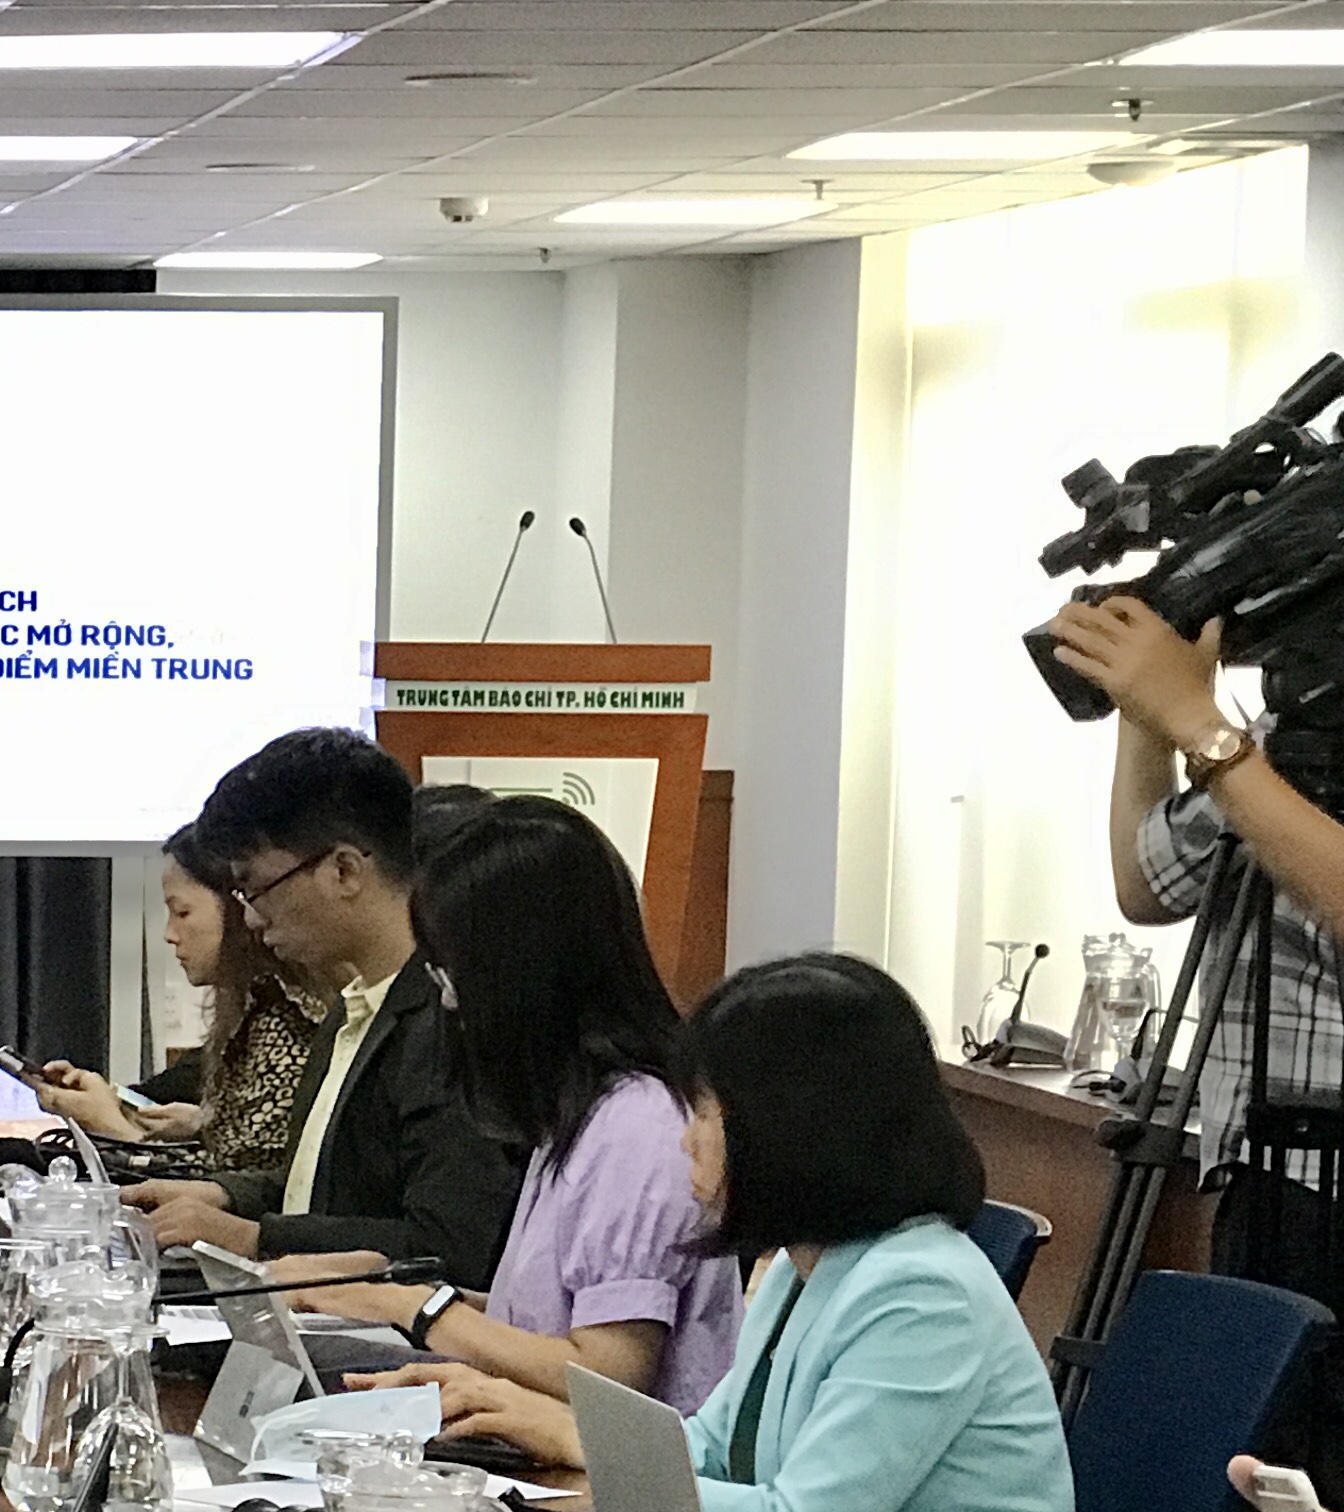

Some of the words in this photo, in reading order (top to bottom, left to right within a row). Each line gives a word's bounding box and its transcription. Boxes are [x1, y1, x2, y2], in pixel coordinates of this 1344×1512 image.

[27, 618, 72, 647] MỞ
[81, 620, 175, 650] RỘNG,
[66, 650, 142, 680] MIỀN
[150, 658, 254, 681] TRUNG
[397, 688, 449, 707] TRUNG
[452, 686, 485, 708] TÂM
[489, 687, 521, 708] BÁO
[525, 686, 552, 708] CHÍ
[556, 690, 580, 708] TP.
[610, 686, 639, 709] CHÍ
[641, 691, 685, 709] MINH
